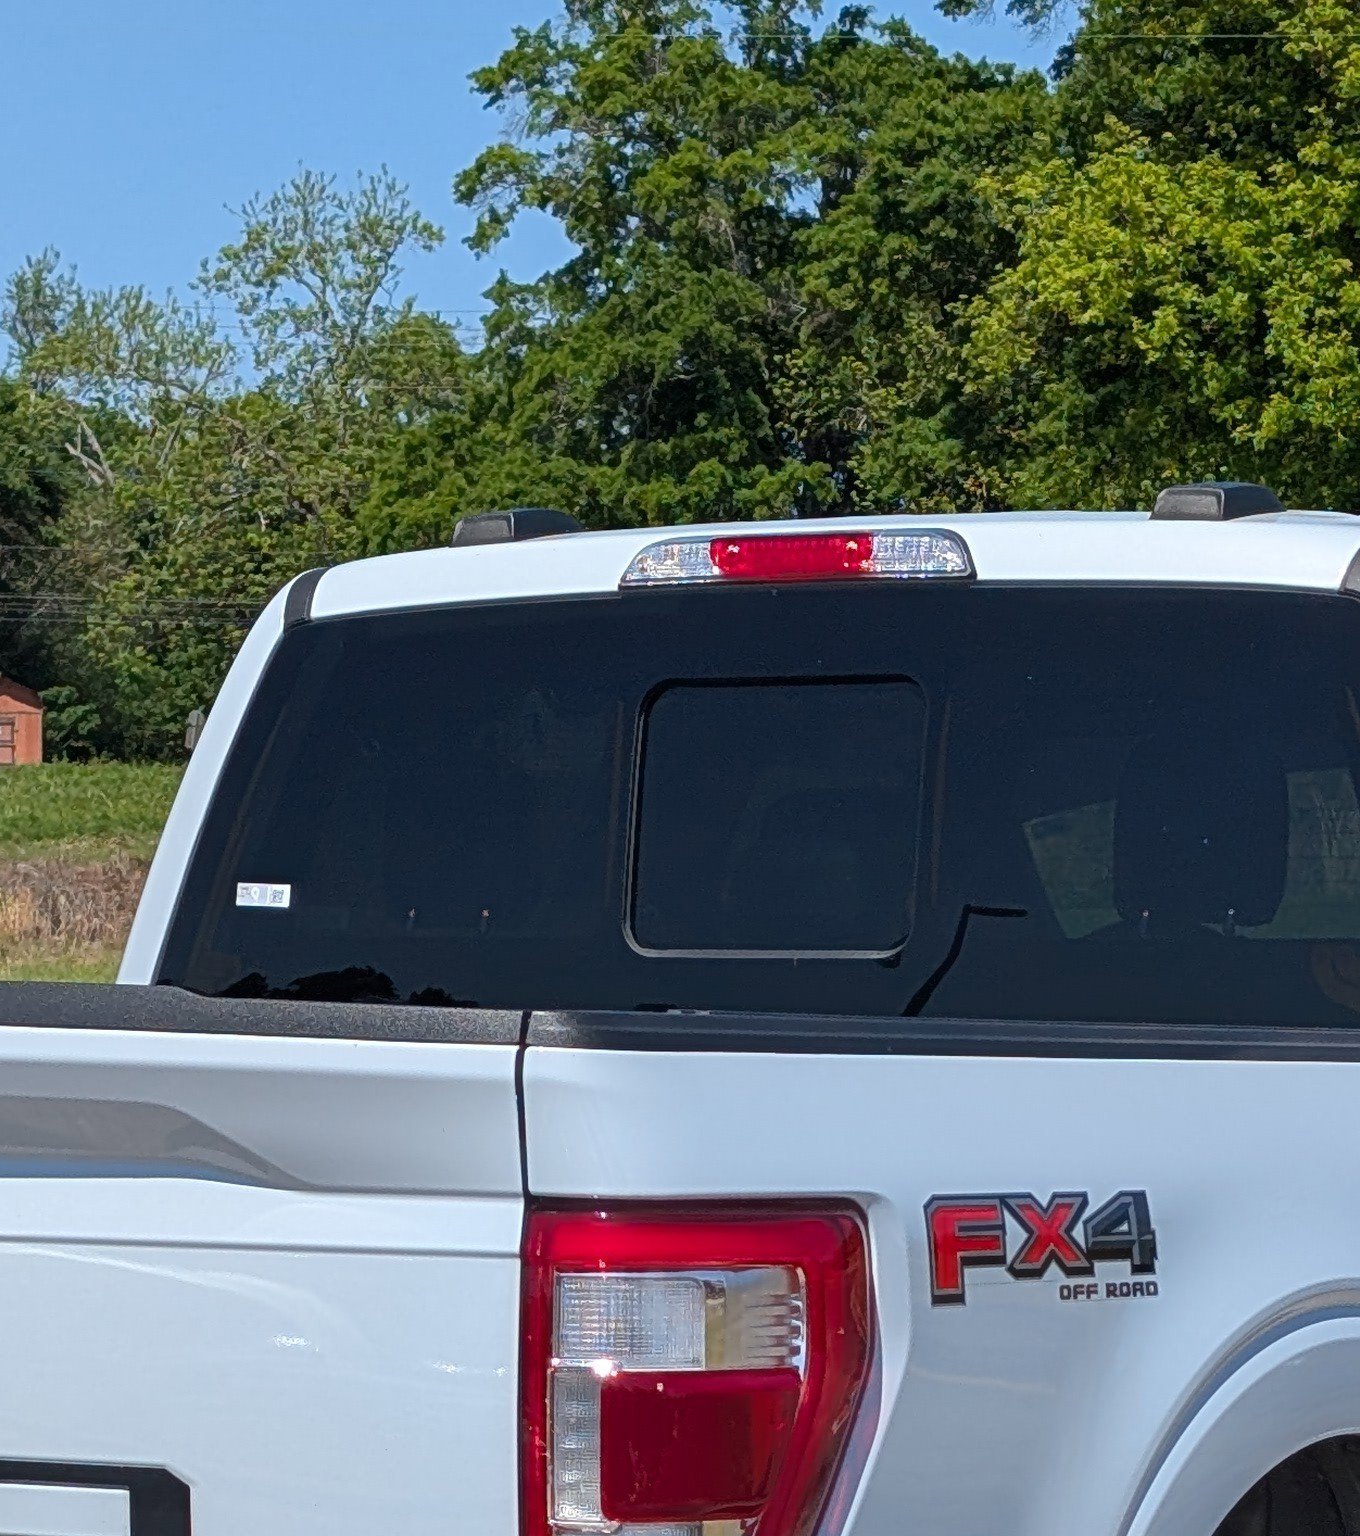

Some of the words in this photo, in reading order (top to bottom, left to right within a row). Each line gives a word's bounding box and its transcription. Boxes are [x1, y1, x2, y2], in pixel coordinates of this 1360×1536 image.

[923, 1190, 1158, 1307] FX4
[1059, 1284, 1098, 1300] OFF
[1105, 1280, 1159, 1298] ROAD
